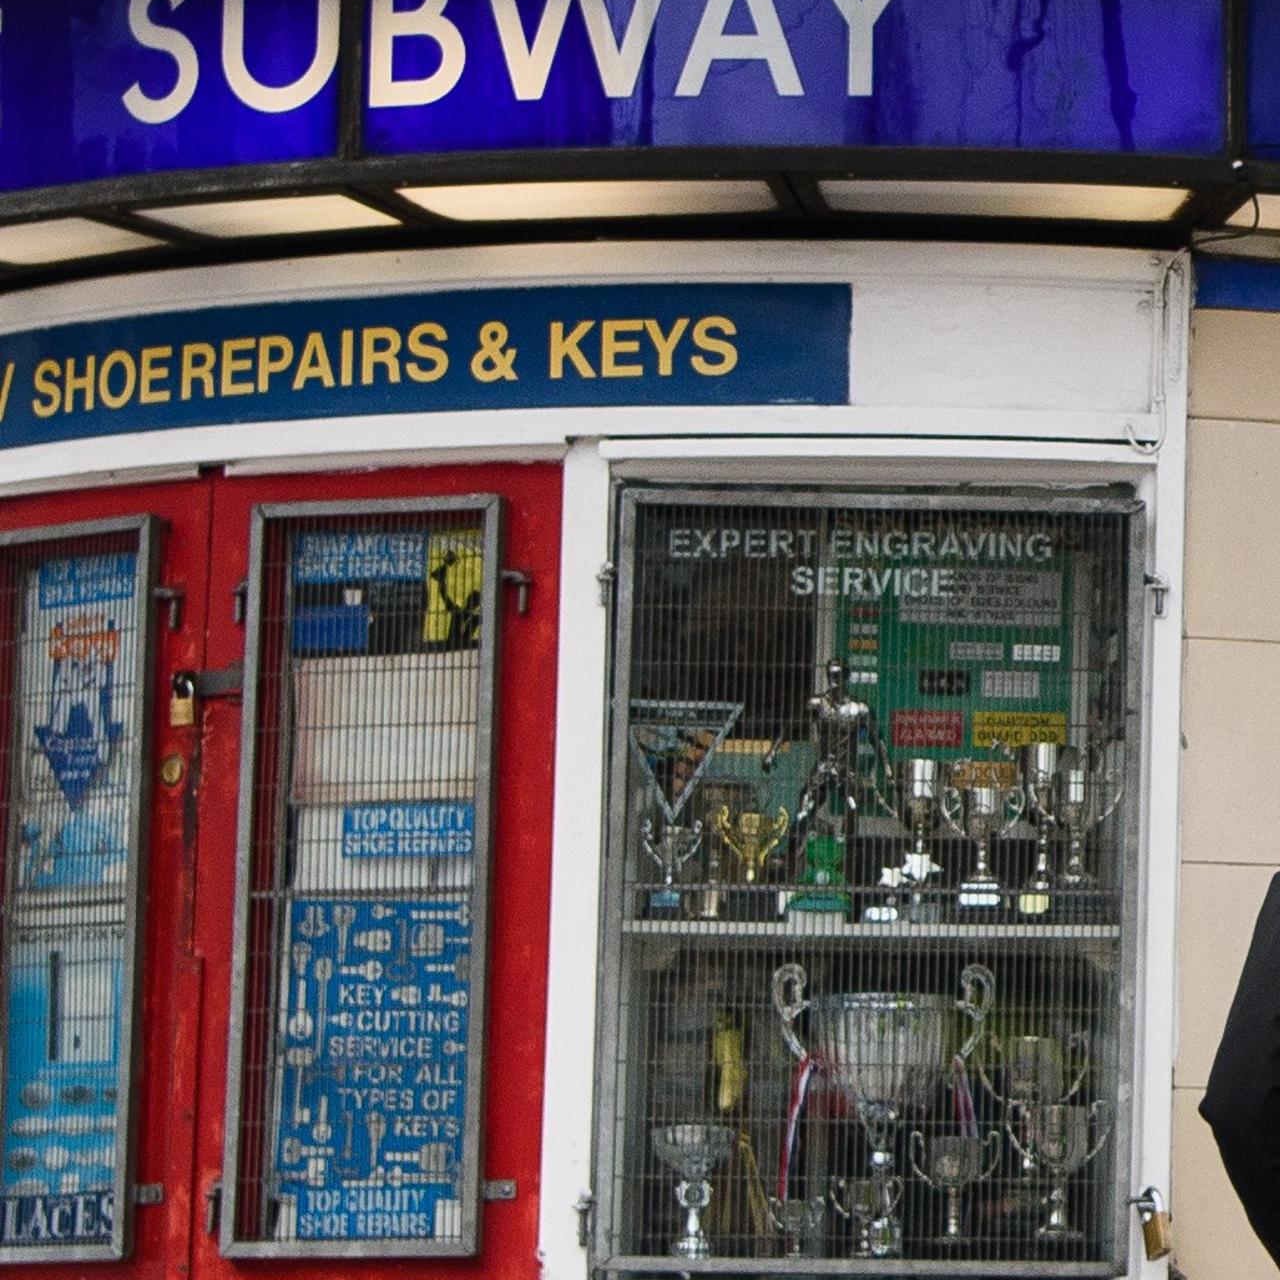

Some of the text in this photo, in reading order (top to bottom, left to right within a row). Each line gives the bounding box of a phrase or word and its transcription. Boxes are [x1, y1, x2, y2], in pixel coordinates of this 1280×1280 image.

[470, 321, 519, 382] &
[548, 316, 738, 379] KEYS
[669, 528, 1053, 561] EXPERT ENGRAVING
[299, 555, 423, 578] SHOE REPAIRS
[790, 566, 955, 597] SERVICE
[354, 805, 464, 831] TOP QUALITY
[344, 829, 472, 855] SHOE REPAIRS
[339, 983, 387, 1006] KEY
[356, 1010, 460, 1033] CUTTING
[329, 1035, 434, 1058] SERVICE
[353, 1063, 463, 1086] FOR ALL
[338, 1087, 457, 1111] TYPES OF
[394, 1115, 460, 1138] KEYS
[307, 1188, 426, 1213] TOP QUALITY
[300, 1212, 428, 1238] SHOE REPAIRS
